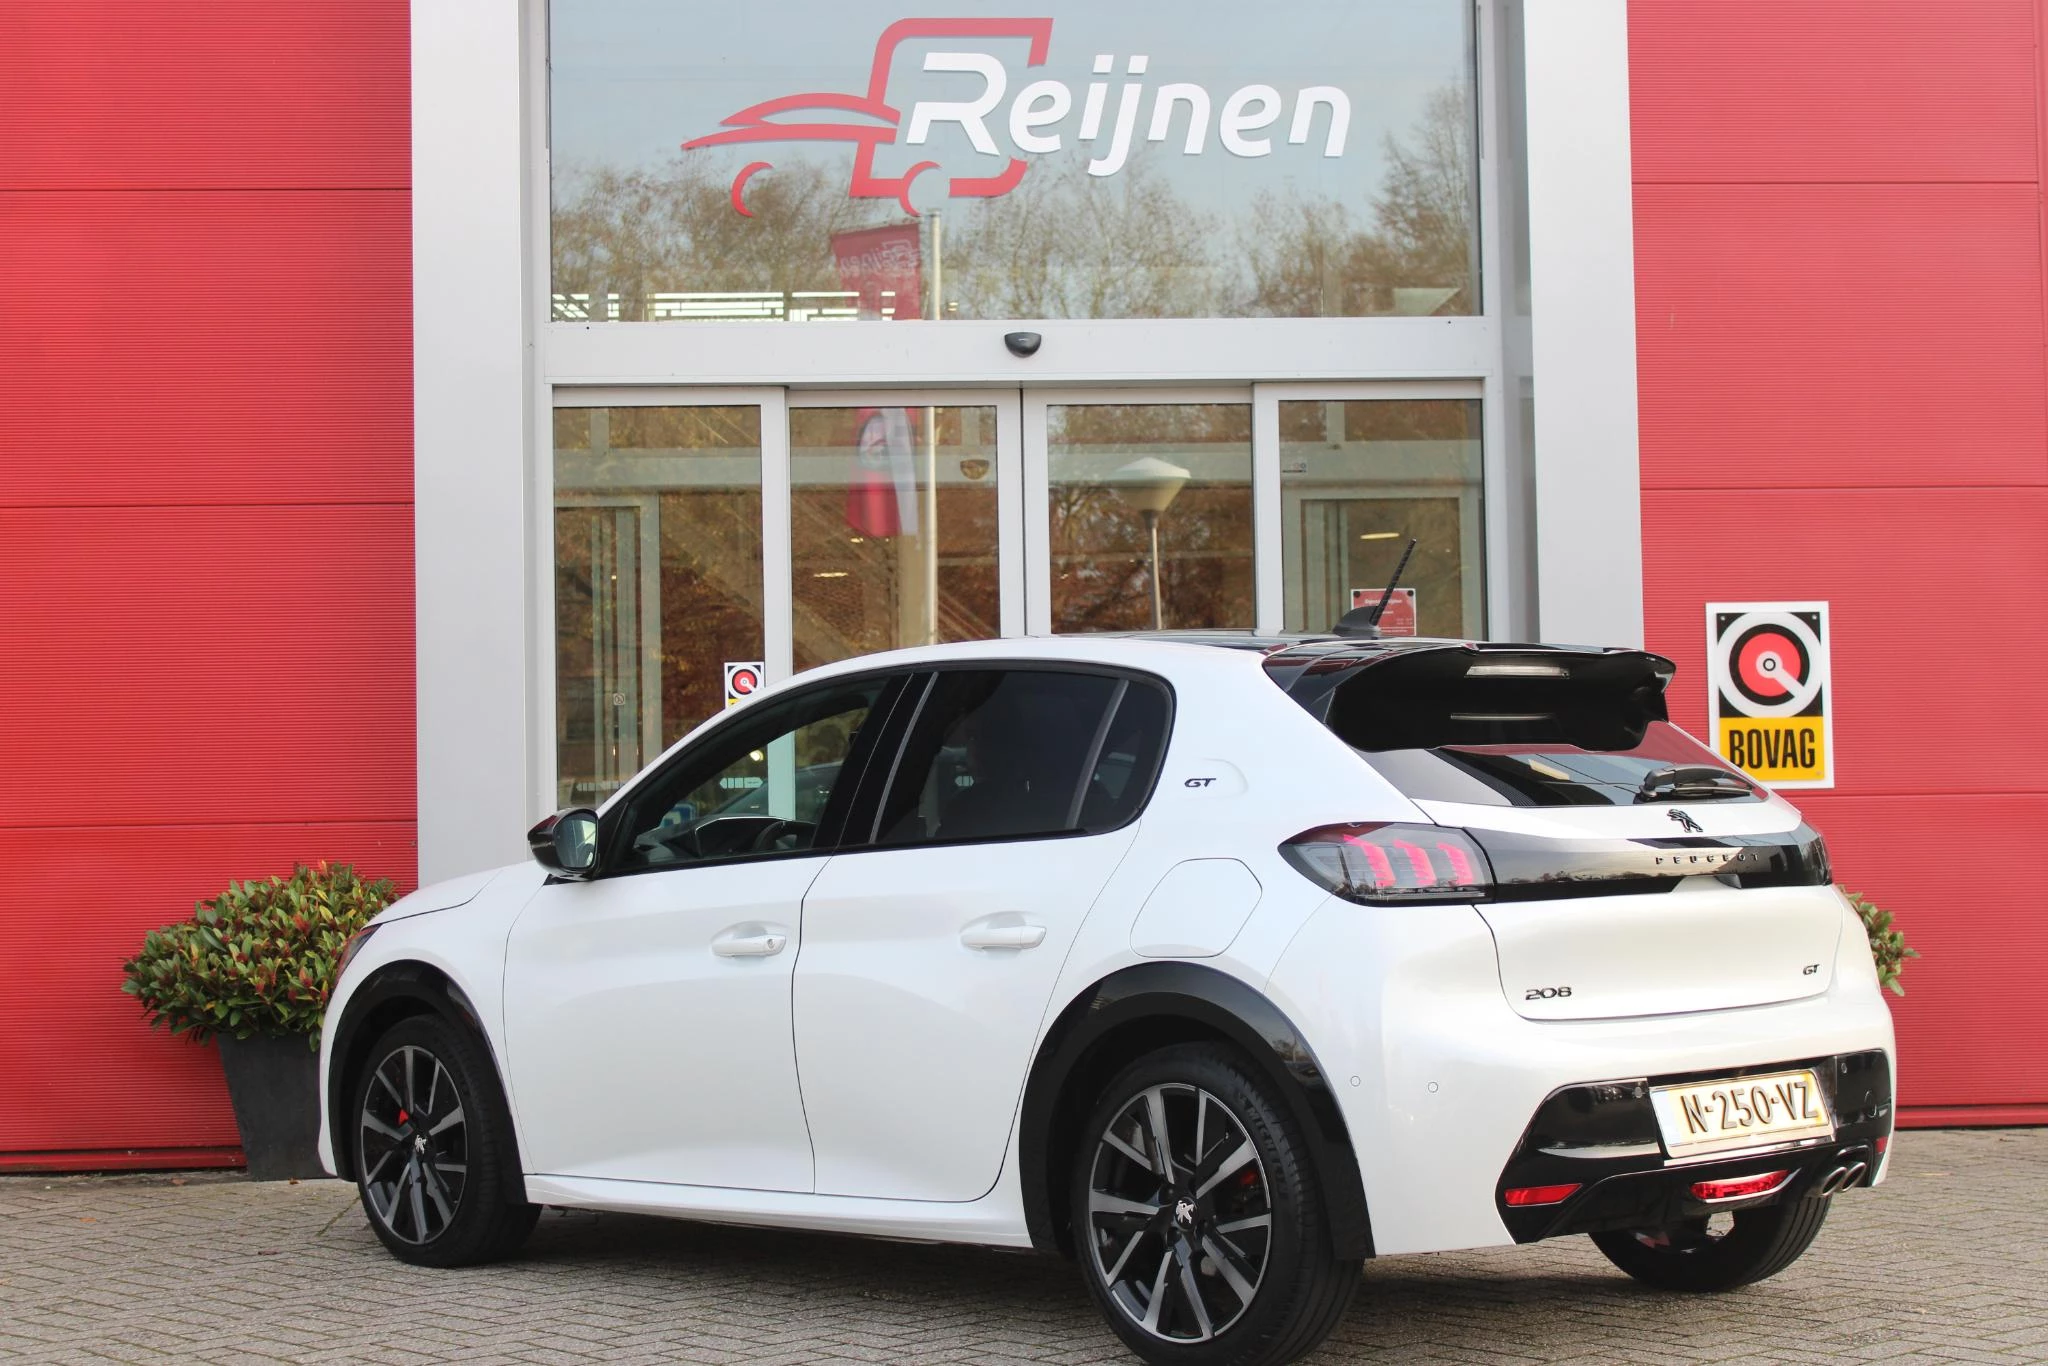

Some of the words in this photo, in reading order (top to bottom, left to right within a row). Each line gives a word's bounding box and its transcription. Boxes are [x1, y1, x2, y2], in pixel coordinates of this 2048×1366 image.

[906, 52, 1351, 177] Reijnen
[1728, 728, 1816, 770] BOVAG
[1184, 777, 1217, 788] GT
[1655, 853, 1758, 865] PEUGEOT
[1803, 963, 1820, 975] GT
[1525, 986, 1572, 1000] 208
[1680, 1080, 1819, 1134] N-250-VZ
